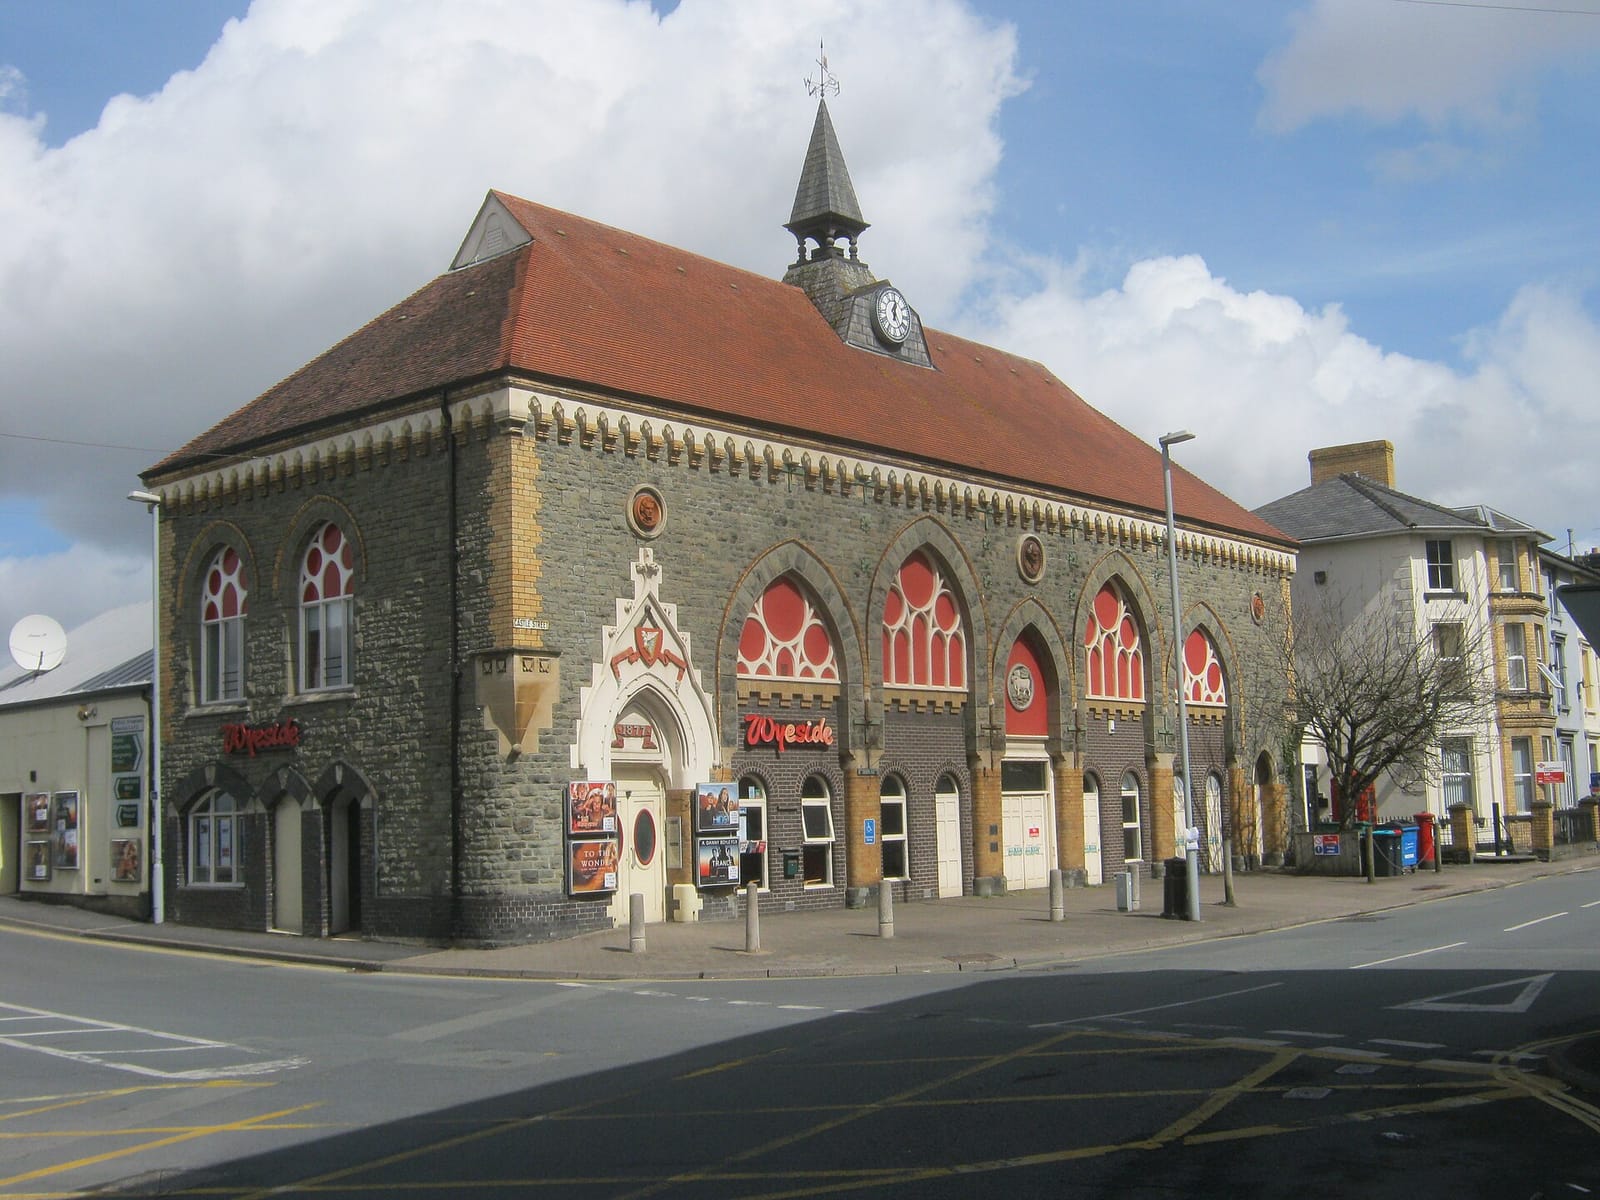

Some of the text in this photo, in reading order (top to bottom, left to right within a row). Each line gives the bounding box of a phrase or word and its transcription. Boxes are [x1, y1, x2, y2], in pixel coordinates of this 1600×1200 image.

[222, 717, 300, 758] Wyeside
[624, 725, 646, 736] 1877
[744, 714, 834, 752] Wyeside
[584, 850, 595, 858] TO
